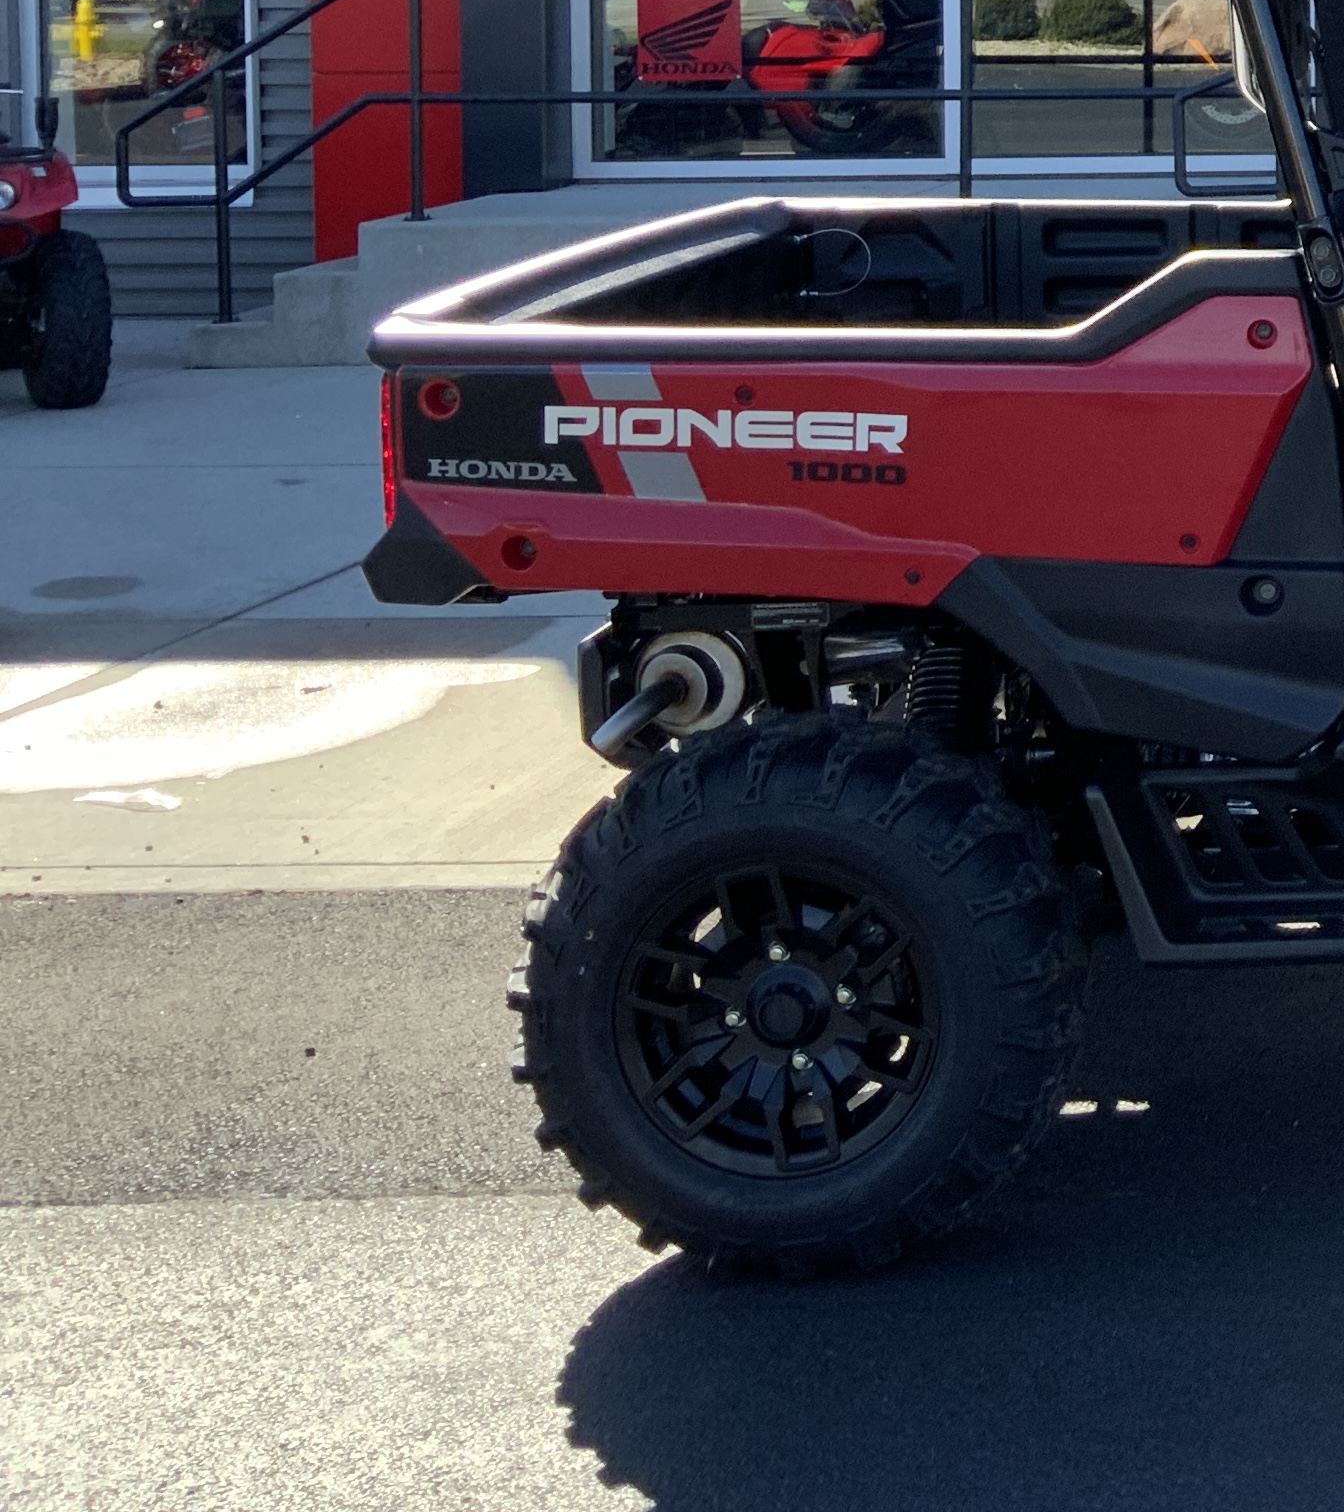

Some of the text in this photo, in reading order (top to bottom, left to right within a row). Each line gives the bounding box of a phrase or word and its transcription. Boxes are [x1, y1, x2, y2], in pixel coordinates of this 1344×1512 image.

[641, 61, 740, 75] HONDA
[543, 404, 909, 454] PIONEER
[426, 458, 577, 482] HONDA
[788, 461, 907, 484] 1000
